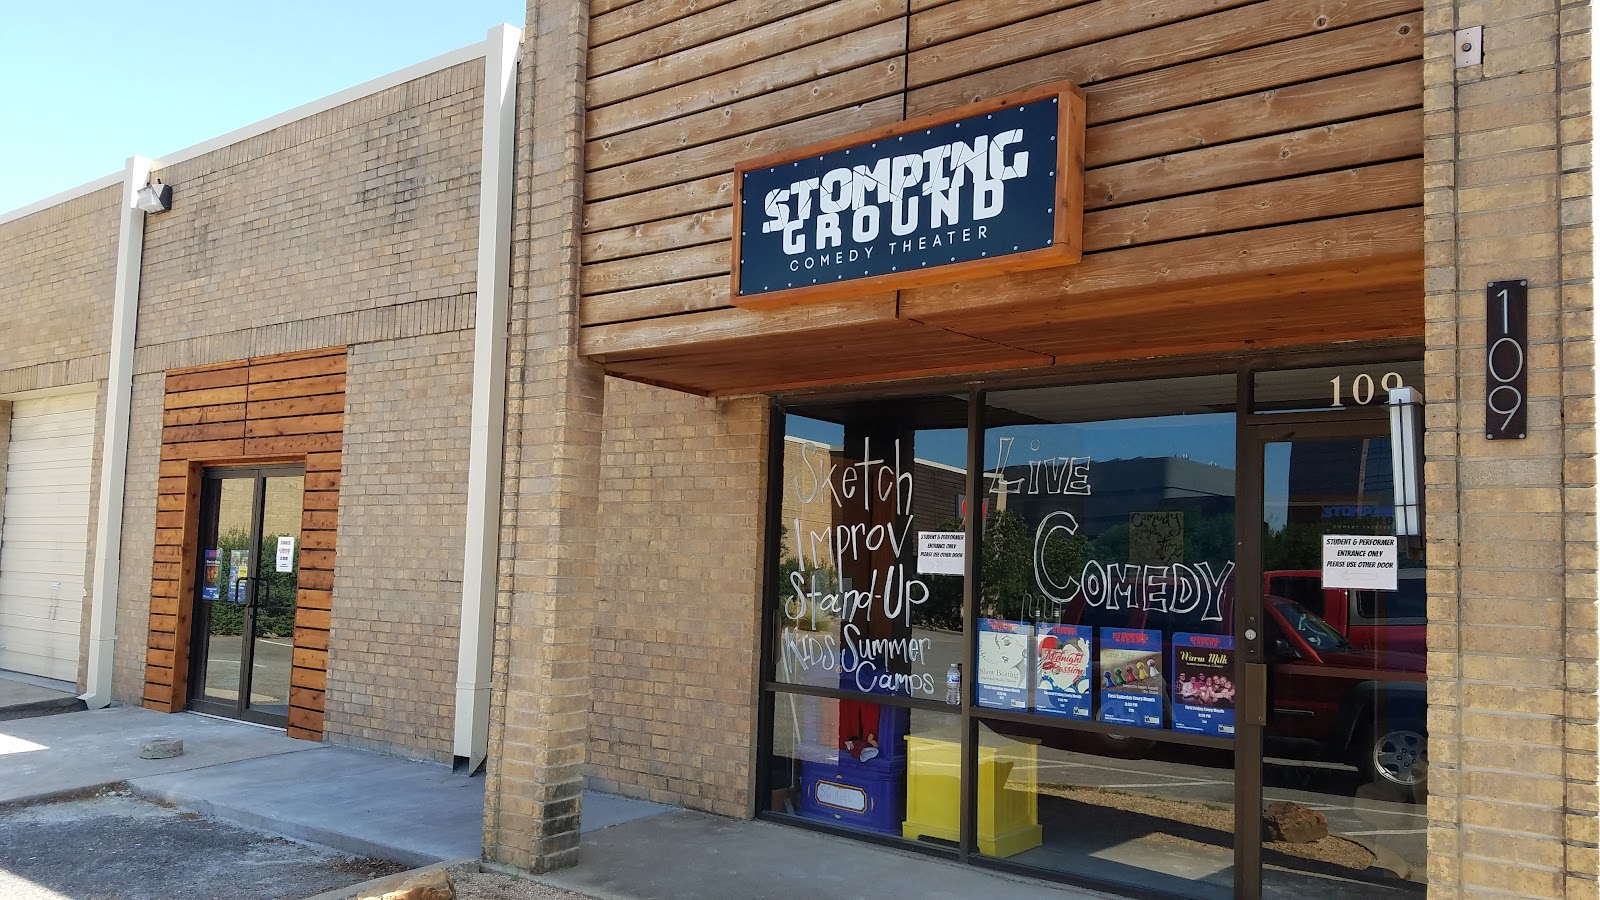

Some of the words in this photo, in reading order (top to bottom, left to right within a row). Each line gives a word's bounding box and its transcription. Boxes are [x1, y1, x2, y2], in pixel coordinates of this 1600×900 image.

[762, 129, 1029, 233] STOMPING
[783, 179, 1004, 255] GROUND
[790, 247, 874, 271] COMEDY
[888, 225, 988, 255] THEATER
[1488, 289, 1523, 431] 109
[794, 437, 913, 515] Sketch
[794, 514, 913, 592] Improv
[1337, 549, 1366, 557] ENTRANCE
[841, 624, 931, 672] Summer
[1043, 649, 1084, 665] Midnight
[1180, 651, 1205, 662] Warm
[1208, 653, 1228, 665] Milk
[856, 661, 934, 696] Camps
